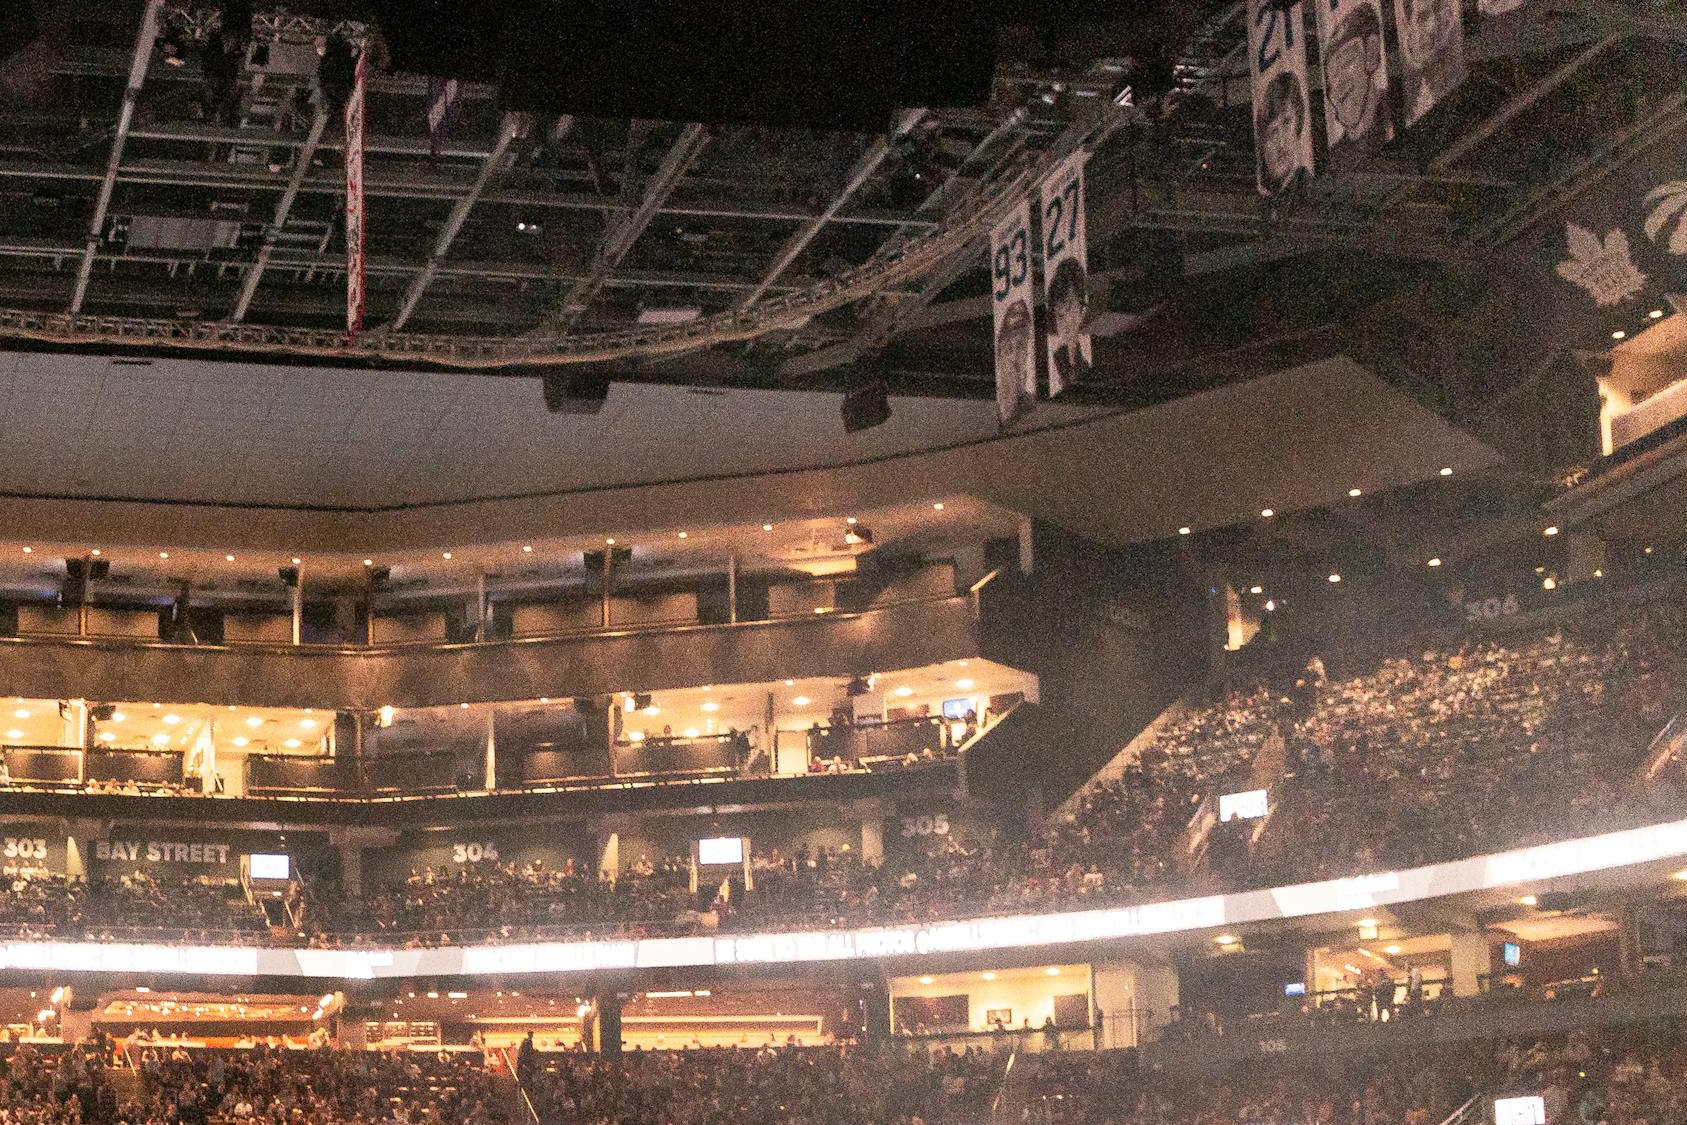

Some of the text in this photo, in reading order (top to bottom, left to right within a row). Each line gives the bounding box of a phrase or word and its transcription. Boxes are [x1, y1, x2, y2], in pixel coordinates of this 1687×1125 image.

[1047, 178, 1080, 260] 27
[995, 227, 1027, 301] 93
[3, 838, 48, 859] 303
[96, 841, 231, 864] BAY STREET
[452, 842, 499, 863] 304
